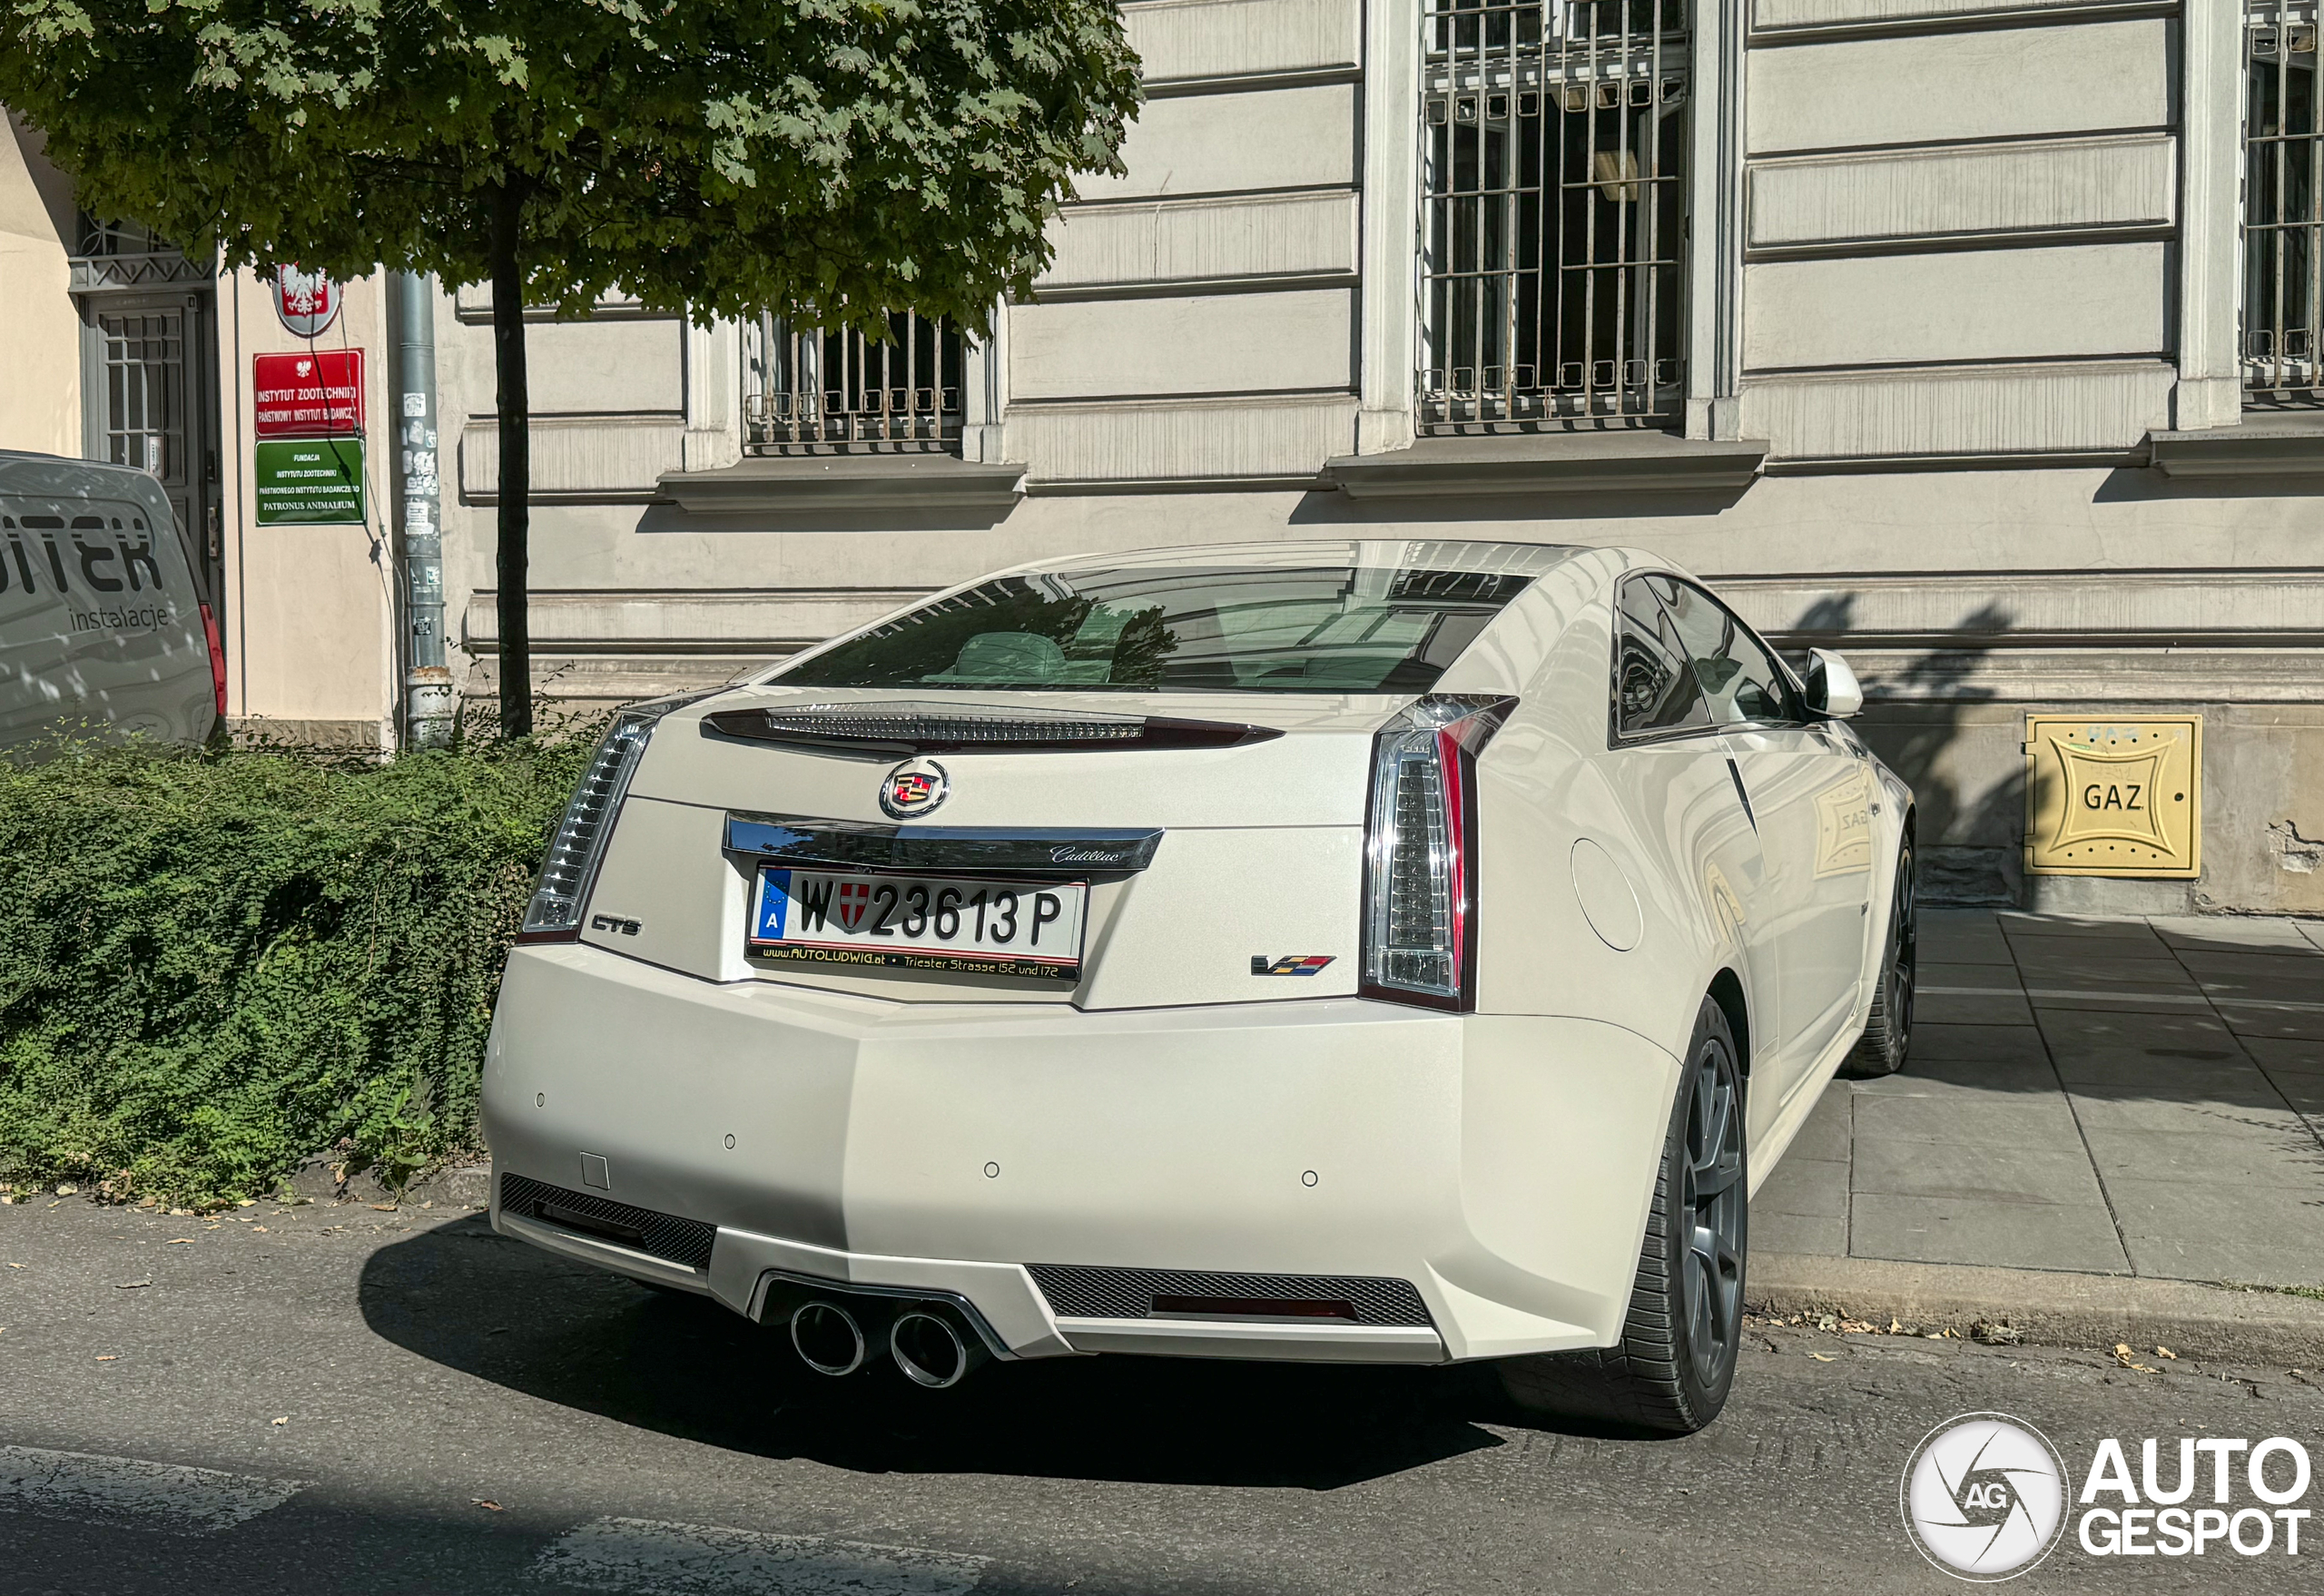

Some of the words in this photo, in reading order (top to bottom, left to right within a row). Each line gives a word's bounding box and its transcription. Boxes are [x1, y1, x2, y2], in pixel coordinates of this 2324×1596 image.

[258, 389, 295, 402] INSTYTUT
[298, 387, 357, 400] ZOOTECHNIKI
[258, 409, 291, 423] PAŃSTWOWY
[293, 409, 321, 421] INSTYTUT
[276, 470, 303, 478] INSTYTUTU
[263, 502, 305, 510] PATRONUS
[306, 500, 355, 509] ANIMALIUM
[68, 604, 169, 632] instalacje
[2083, 783, 2143, 811] GAZ
[1049, 845, 1119, 863] Cadillac
[765, 912, 778, 929] A
[801, 879, 833, 933] W
[870, 884, 1020, 945] 23613
[1031, 892, 1061, 947] P
[592, 914, 643, 936] CTS
[763, 948, 886, 965] www.AUTOLUDWIG.at
[999, 963, 1016, 974] 152
[1019, 965, 1039, 976] und
[1040, 967, 1059, 978] 172
